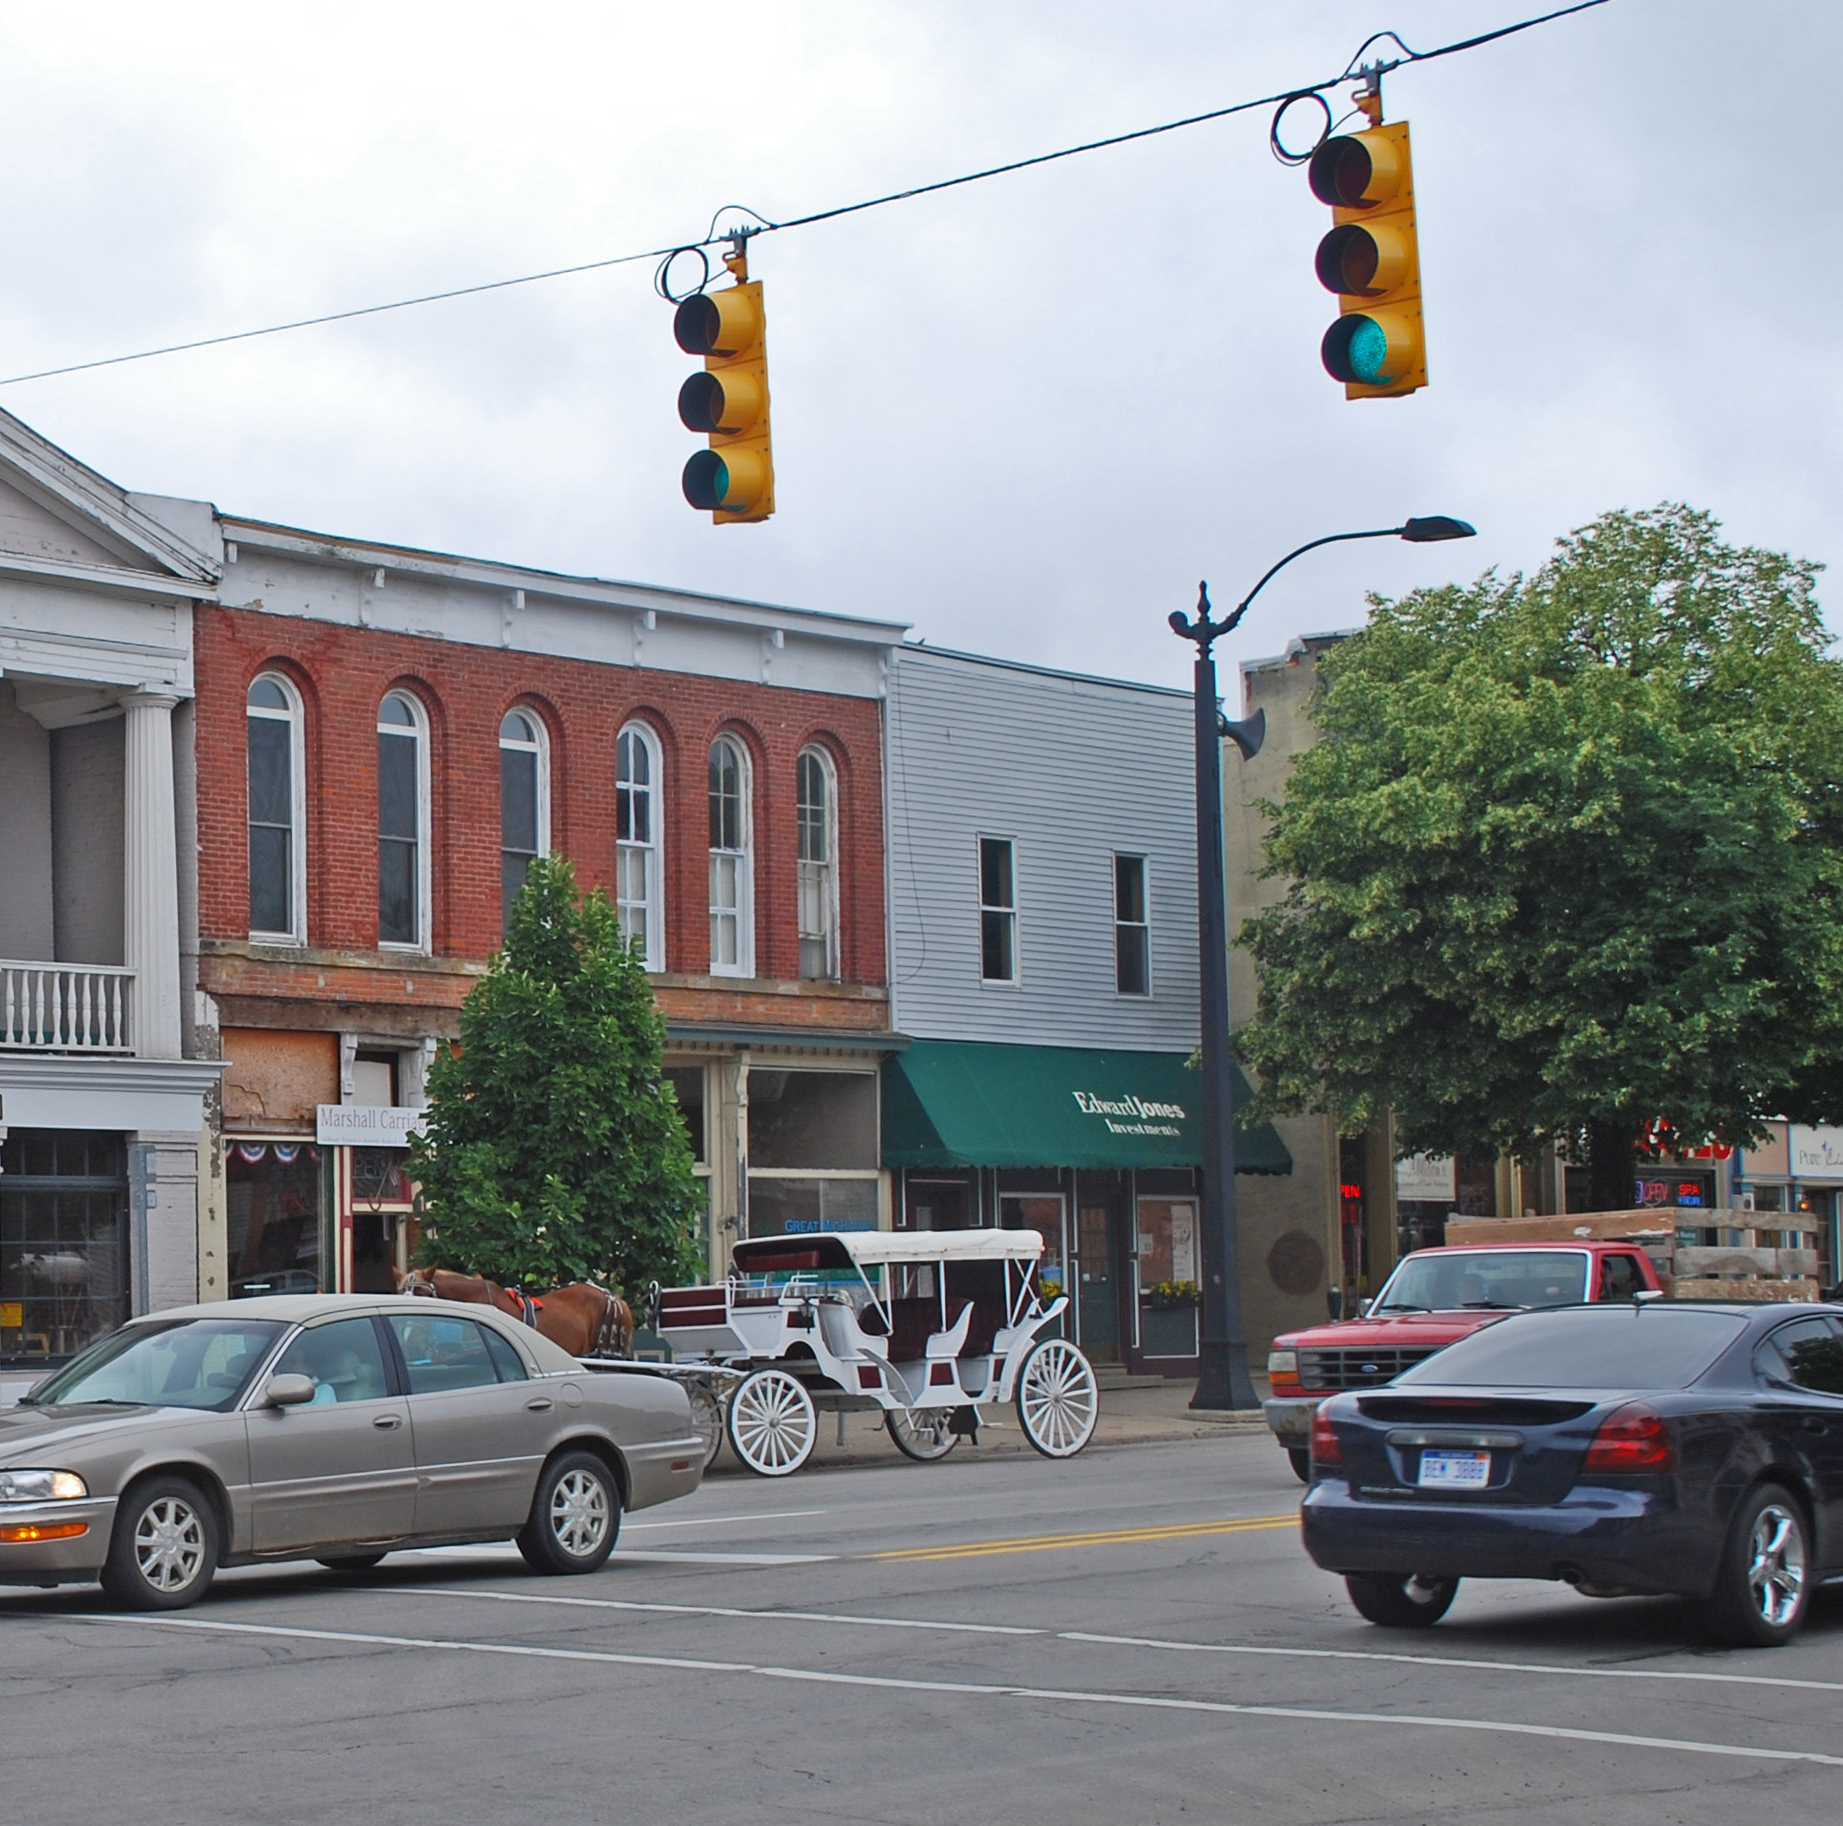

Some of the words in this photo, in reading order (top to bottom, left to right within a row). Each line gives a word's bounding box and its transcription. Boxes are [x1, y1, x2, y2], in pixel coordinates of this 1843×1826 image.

[1072, 1091, 1138, 1116] Edward
[1132, 1096, 1186, 1119] Jones
[321, 1108, 376, 1129] Marshall
[380, 1110, 427, 1135] Carriag
[1104, 1118, 1181, 1136] Investments
[1340, 1184, 1361, 1198] PEN
[784, 1218, 819, 1233] GREAT
